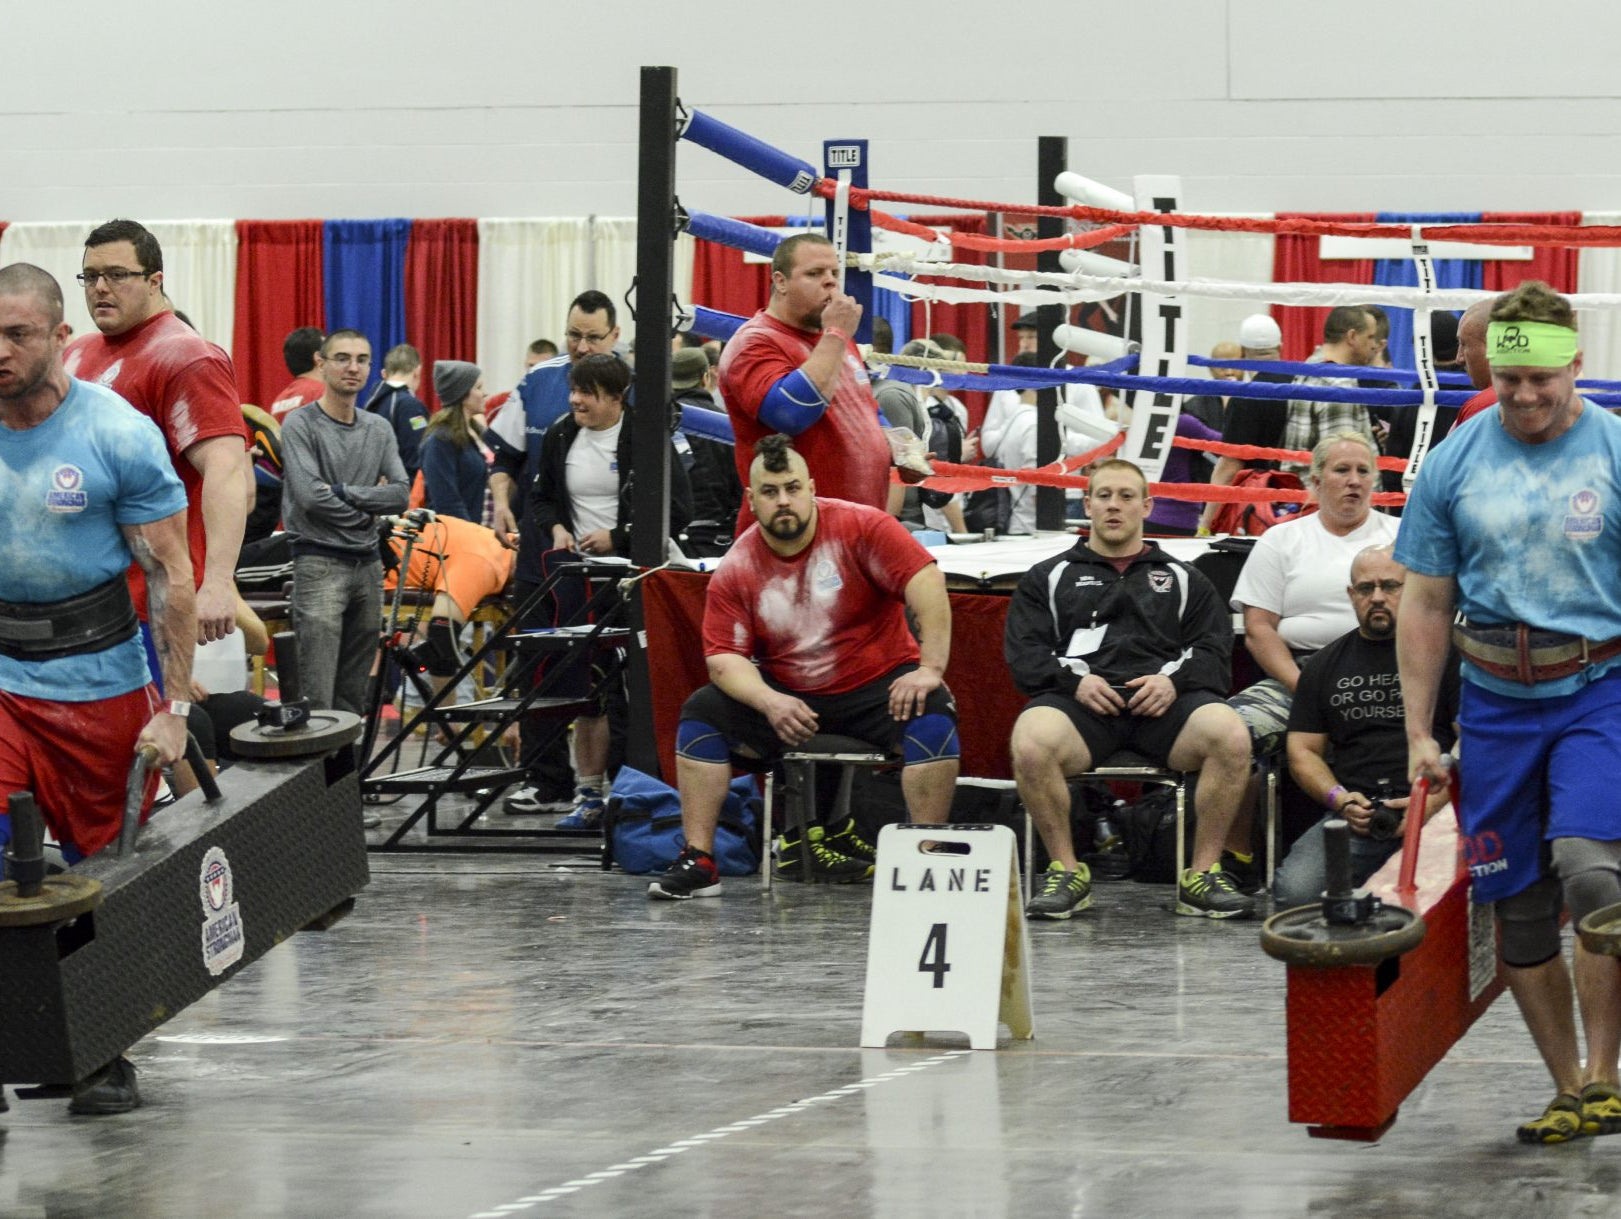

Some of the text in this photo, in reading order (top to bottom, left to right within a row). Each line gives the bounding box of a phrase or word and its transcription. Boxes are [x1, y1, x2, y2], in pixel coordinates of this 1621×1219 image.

[831, 149, 857, 162] TITLE
[1139, 197, 1182, 460] TITLE
[1420, 336, 1434, 388] TITLE
[1410, 421, 1428, 474] TITLE
[1336, 673, 1400, 689] GO HEA
[1330, 691, 1355, 706] OR
[1359, 690, 1386, 702] GO
[1340, 705, 1405, 721] YOURSE
[891, 867, 991, 892] LANE
[918, 923, 952, 988] 4
